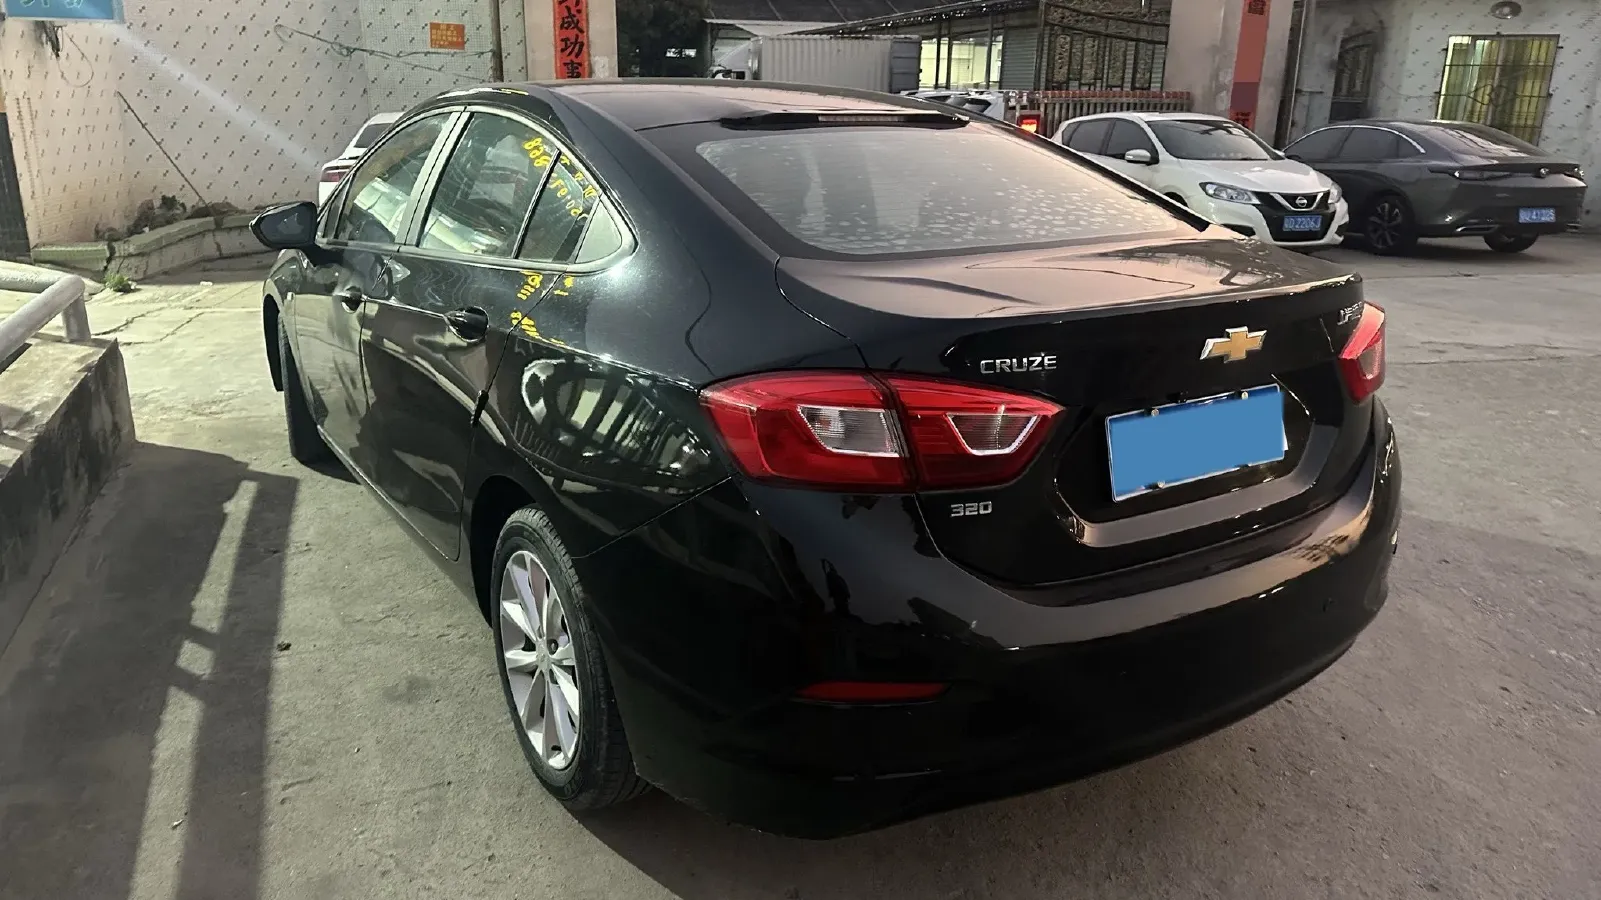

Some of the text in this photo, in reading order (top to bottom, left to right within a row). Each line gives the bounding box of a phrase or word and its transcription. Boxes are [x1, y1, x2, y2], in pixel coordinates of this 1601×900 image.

[558, 0, 585, 78] 成功事
[980, 355, 1057, 374] CRUZE
[950, 501, 992, 517] 320
